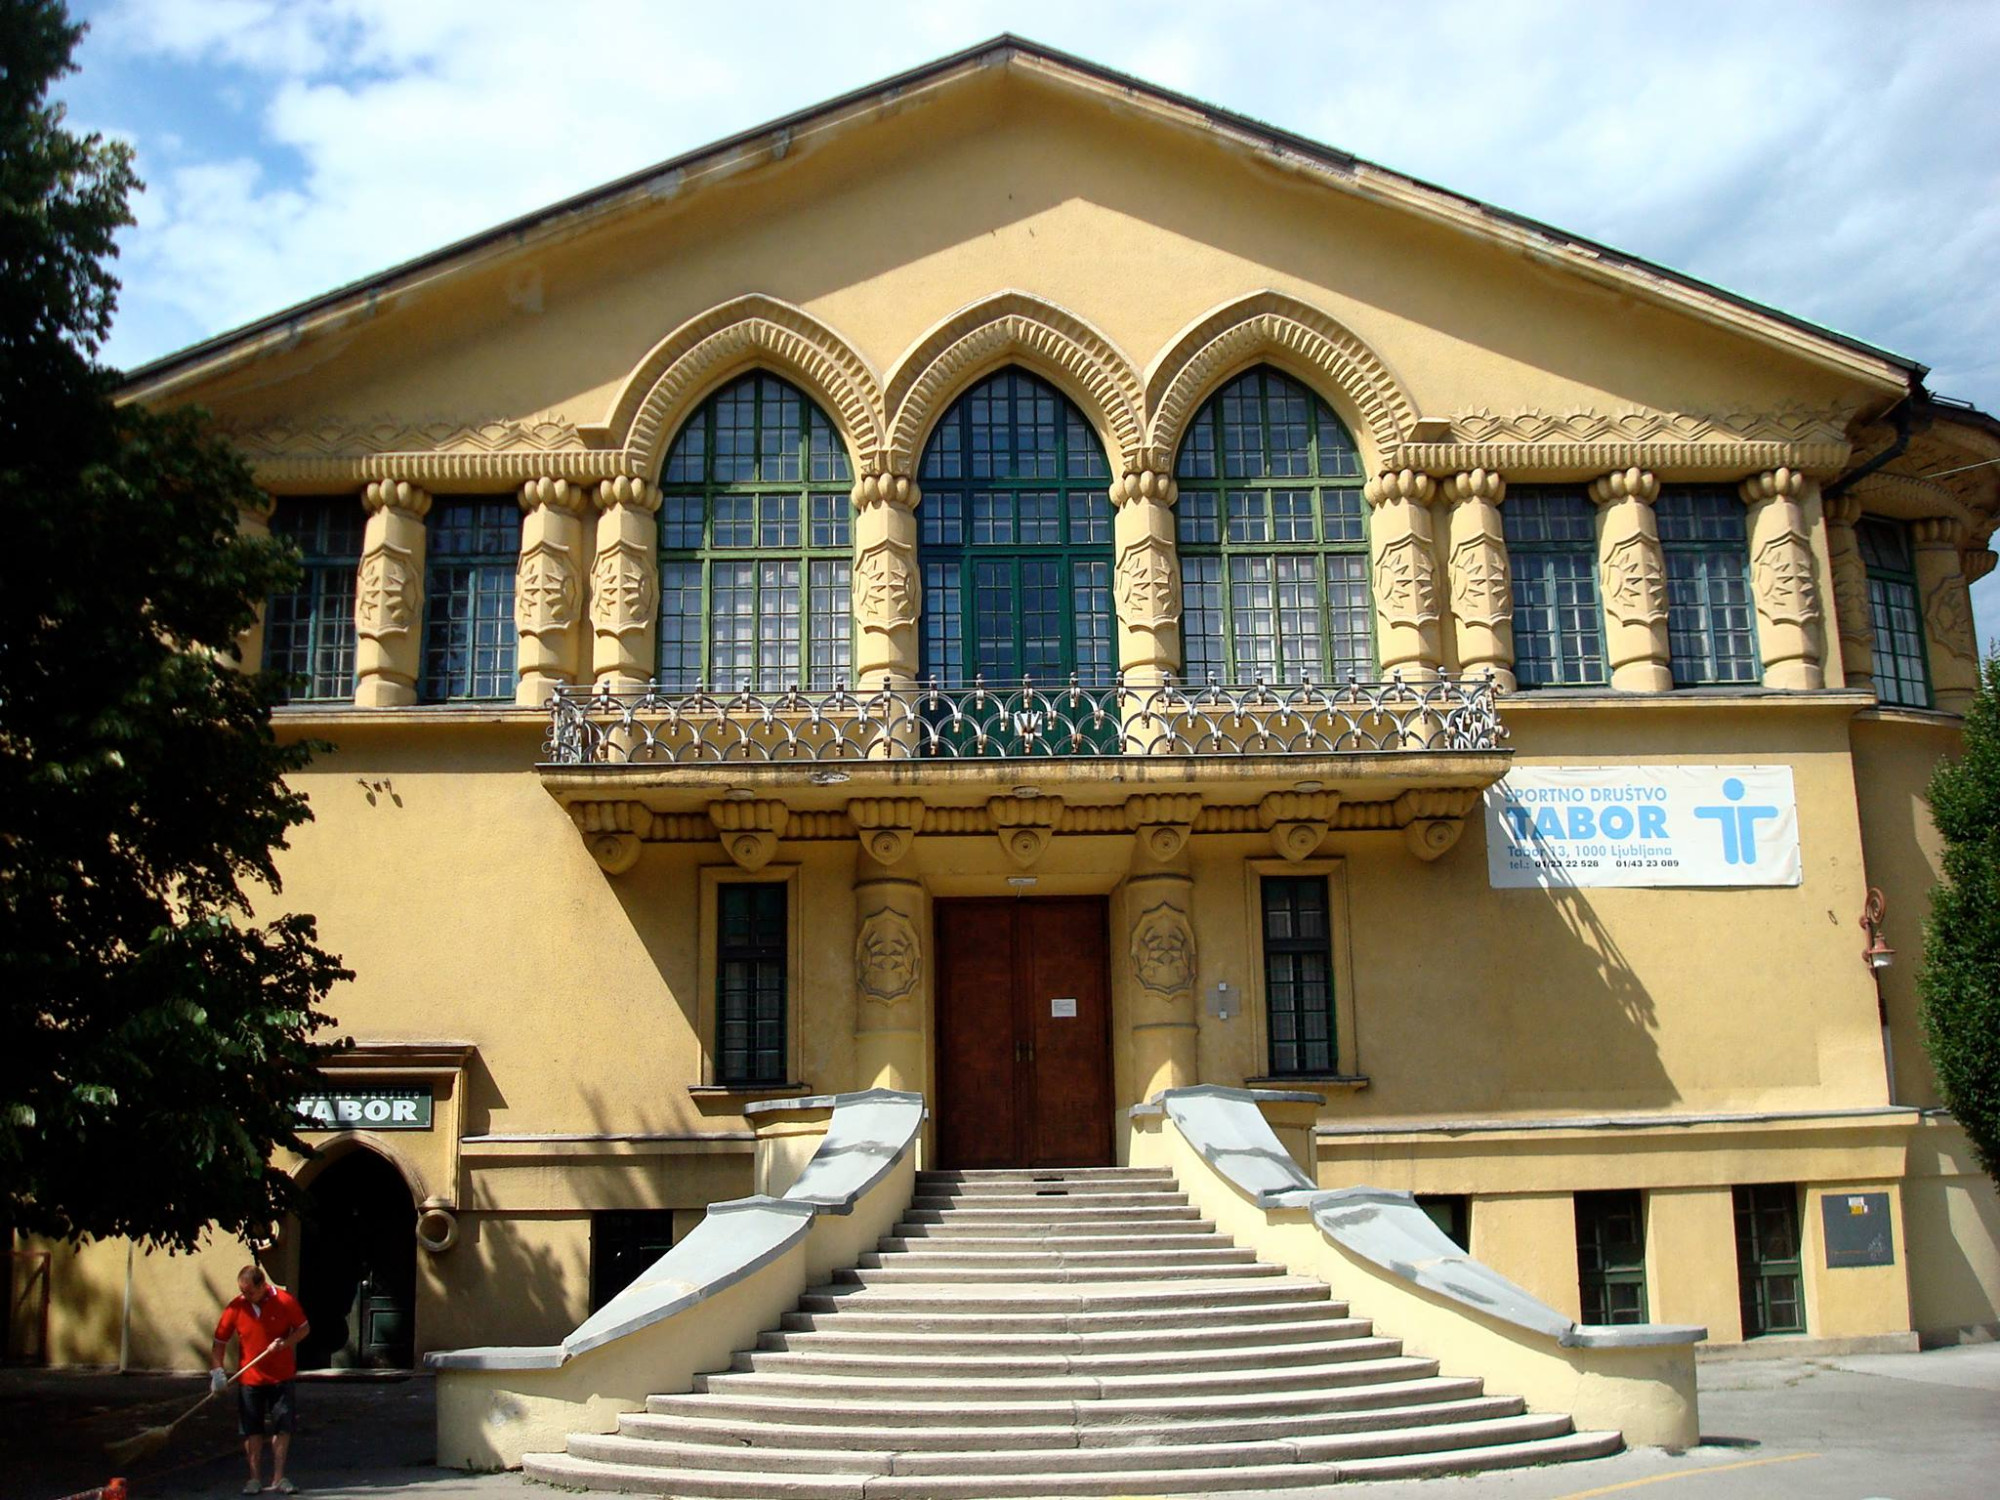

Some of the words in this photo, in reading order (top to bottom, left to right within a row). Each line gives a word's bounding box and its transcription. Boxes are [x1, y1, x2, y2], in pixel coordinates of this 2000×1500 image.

[1591, 783, 1667, 802] DRUŠTVO
[1506, 805, 1670, 840] TABOR
[1508, 844, 1546, 858] Tabor
[1551, 845, 1570, 858] 13,
[1575, 845, 1607, 857] 1000
[1611, 844, 1672, 859] Ljubljana
[1565, 860, 1578, 868] 22
[1615, 859, 1643, 868] 01/43
[1646, 859, 1658, 868] 23
[295, 1100, 418, 1121] TABOR
